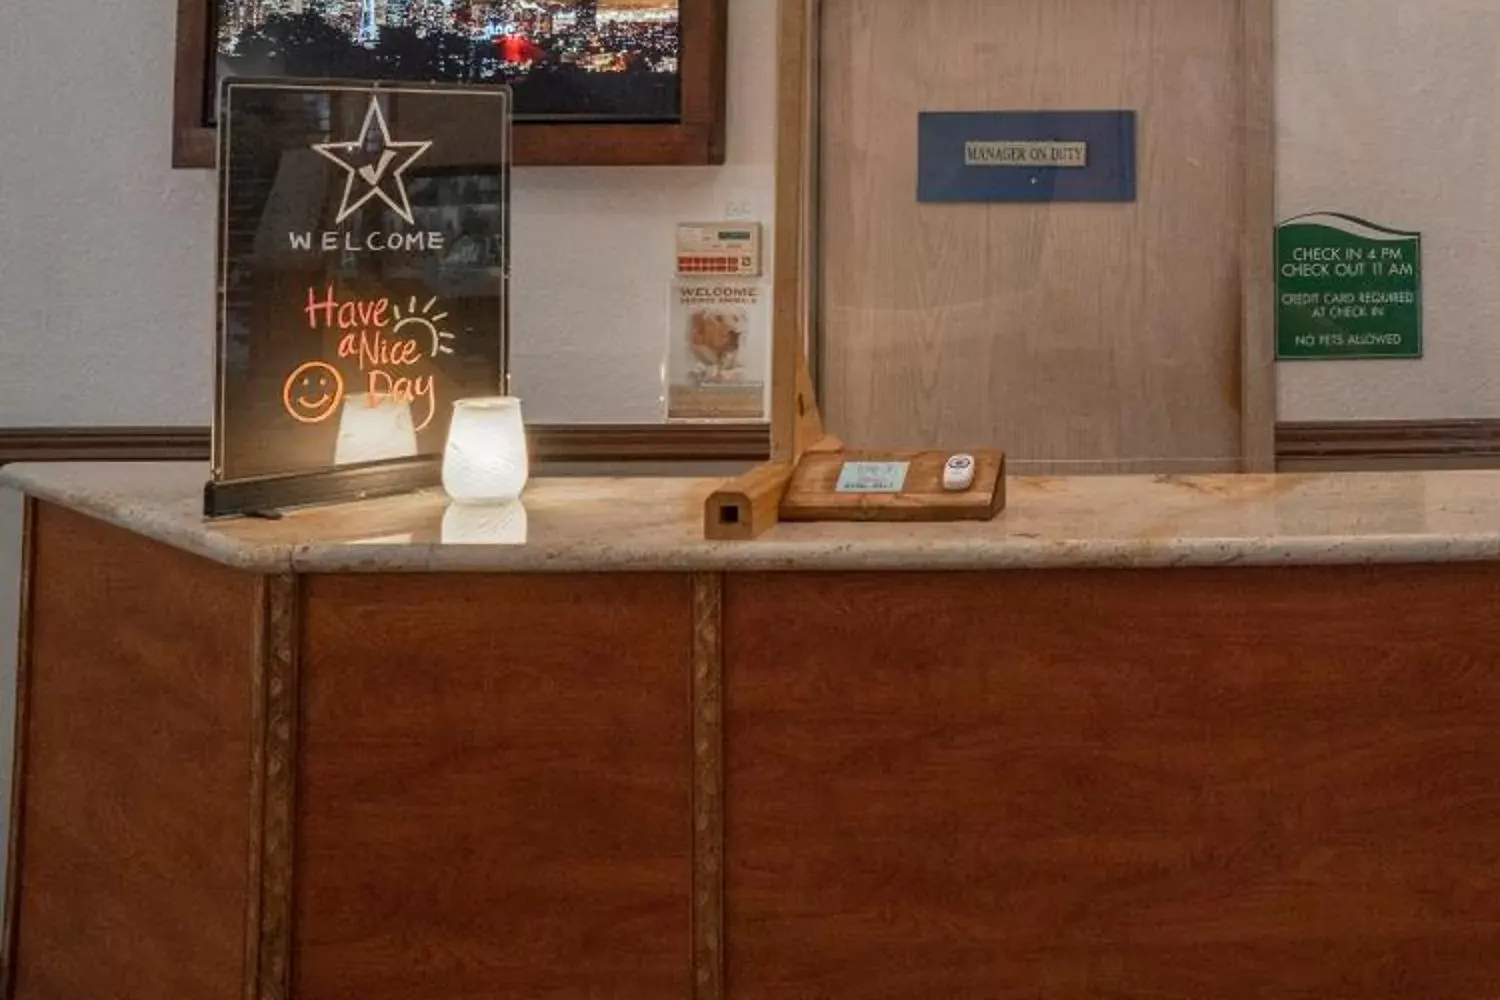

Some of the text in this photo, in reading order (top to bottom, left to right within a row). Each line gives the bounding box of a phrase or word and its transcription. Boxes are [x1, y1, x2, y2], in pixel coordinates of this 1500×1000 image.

[967, 146, 1083, 161] MANAGER ON DUTY
[289, 231, 446, 251] WELCOME
[1292, 247, 1402, 261] CHECK IN 4 PM
[1281, 262, 1413, 277] CHECK OUT 11 AM
[680, 287, 758, 297] WELCOME
[1281, 291, 1414, 305] CREDIT CARD REQUIRED
[304, 280, 391, 329] Have
[1312, 306, 1385, 318] AT CHECK IN
[1295, 335, 1315, 346] NO
[1348, 333, 1402, 345] ALLOWED
[338, 329, 422, 370] a Nice
[367, 369, 436, 432] Day
